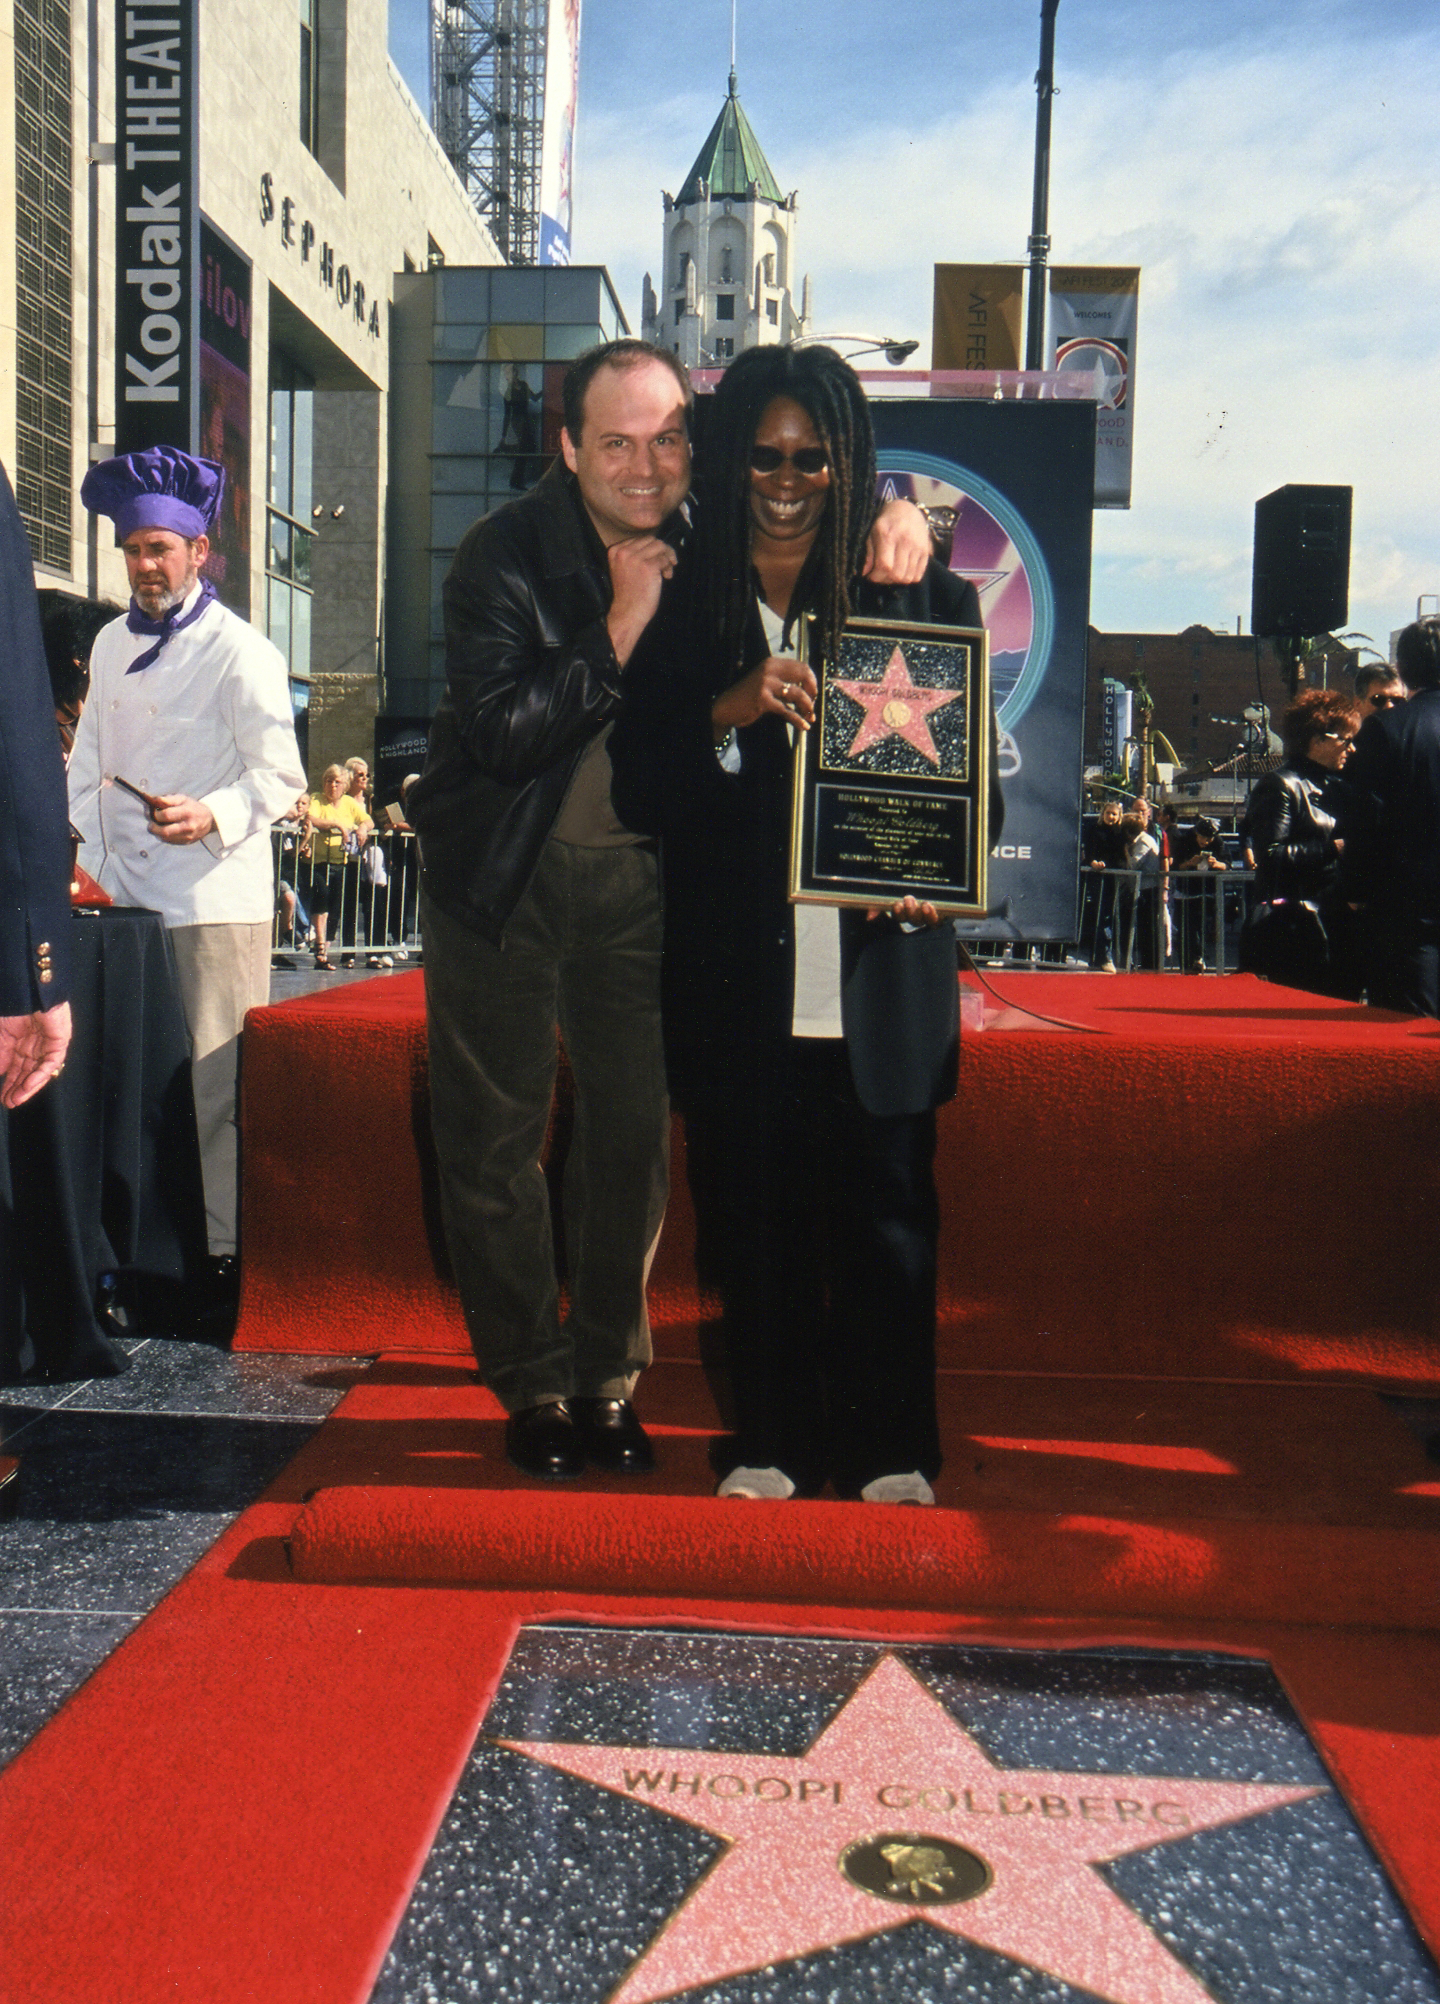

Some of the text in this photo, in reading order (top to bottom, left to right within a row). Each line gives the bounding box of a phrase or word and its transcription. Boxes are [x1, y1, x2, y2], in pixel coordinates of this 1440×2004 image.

[125, 0, 182, 402] Kodak THEAT
[259, 172, 380, 343] SEPHORA
[968, 292, 988, 327] AFI
[1074, 311, 1112, 319] WELCOMES
[965, 333, 987, 371] FES
[1096, 416, 1126, 429] OOD
[380, 737, 427, 752] HOLLYWOOD
[1104, 686, 1114, 779] HOLLYWOOD
[385, 746, 427, 757] HIGHLAND
[622, 1768, 1191, 1827] WHOOPI GOLDBERG
